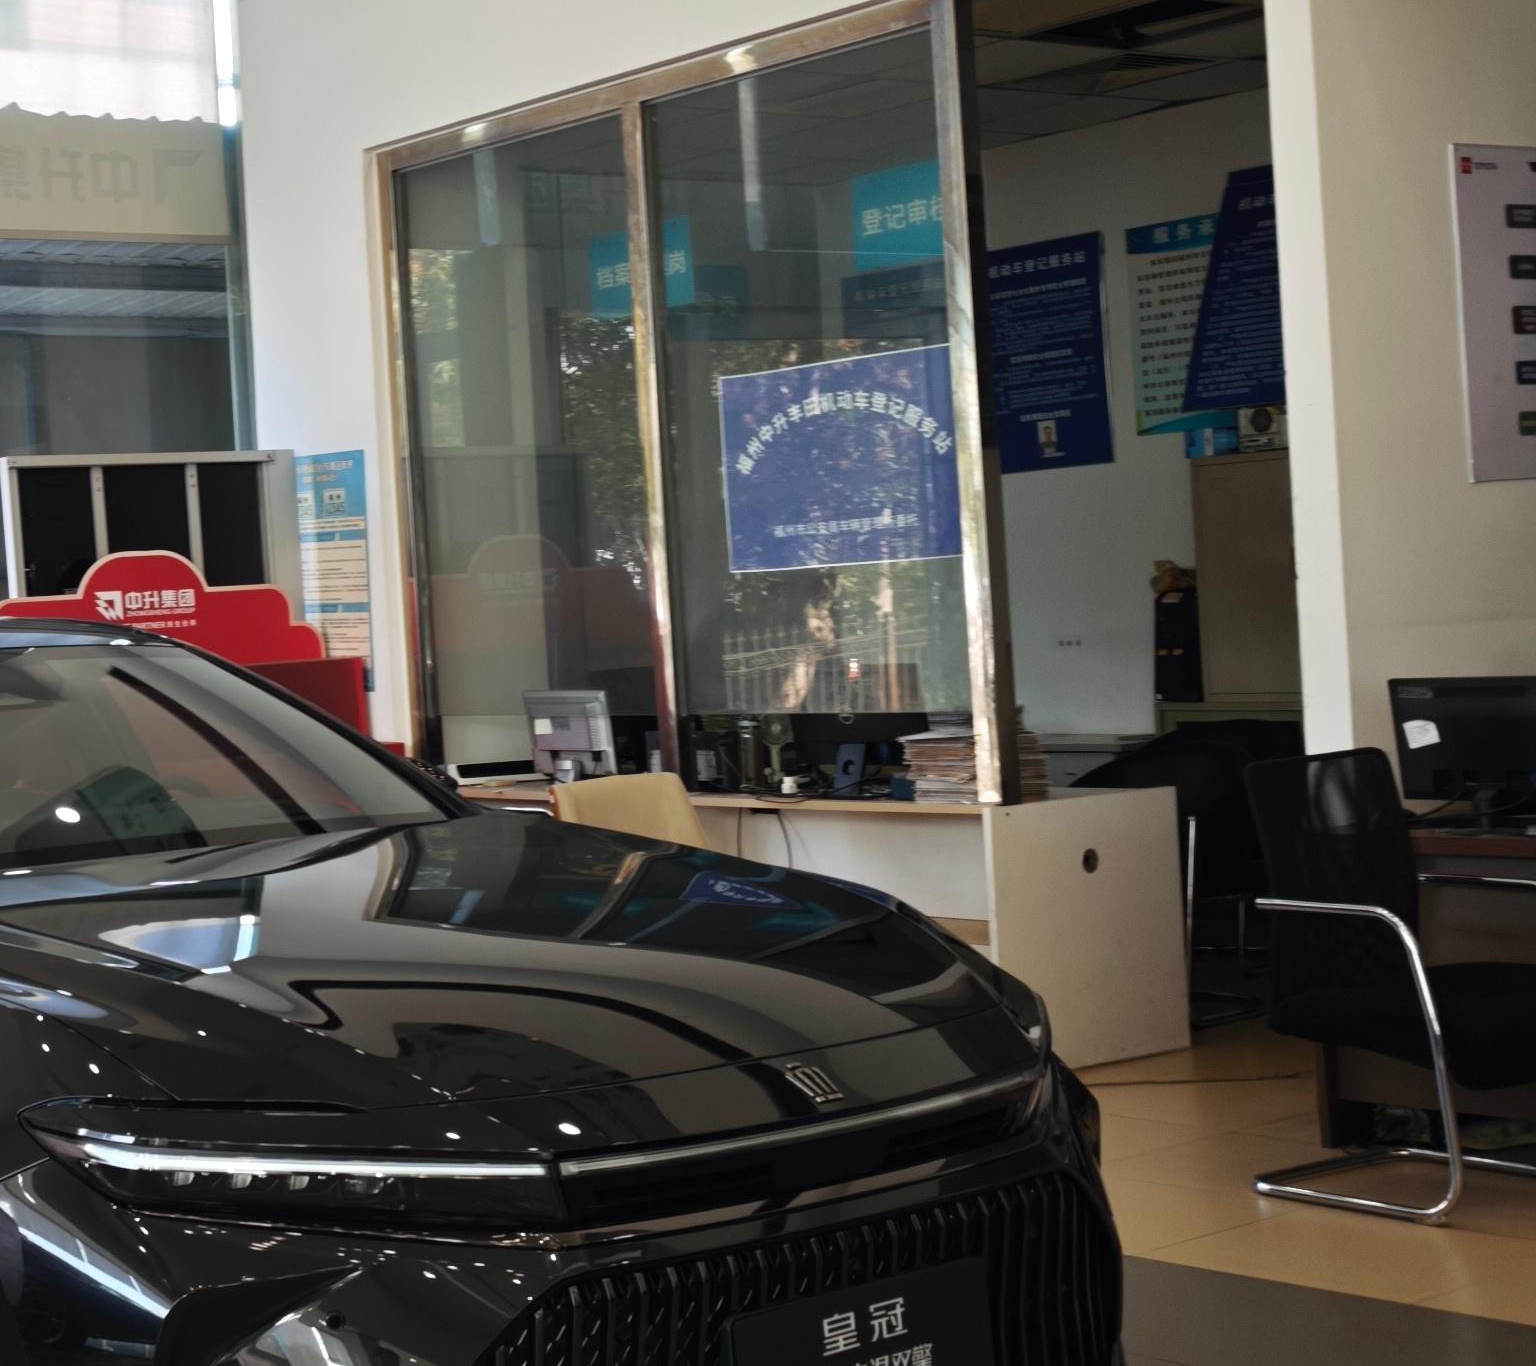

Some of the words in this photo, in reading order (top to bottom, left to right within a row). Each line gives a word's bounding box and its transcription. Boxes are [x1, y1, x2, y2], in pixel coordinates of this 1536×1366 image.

[125, 589, 196, 609] 中升集团
[823, 1297, 908, 1356] 皇冠
